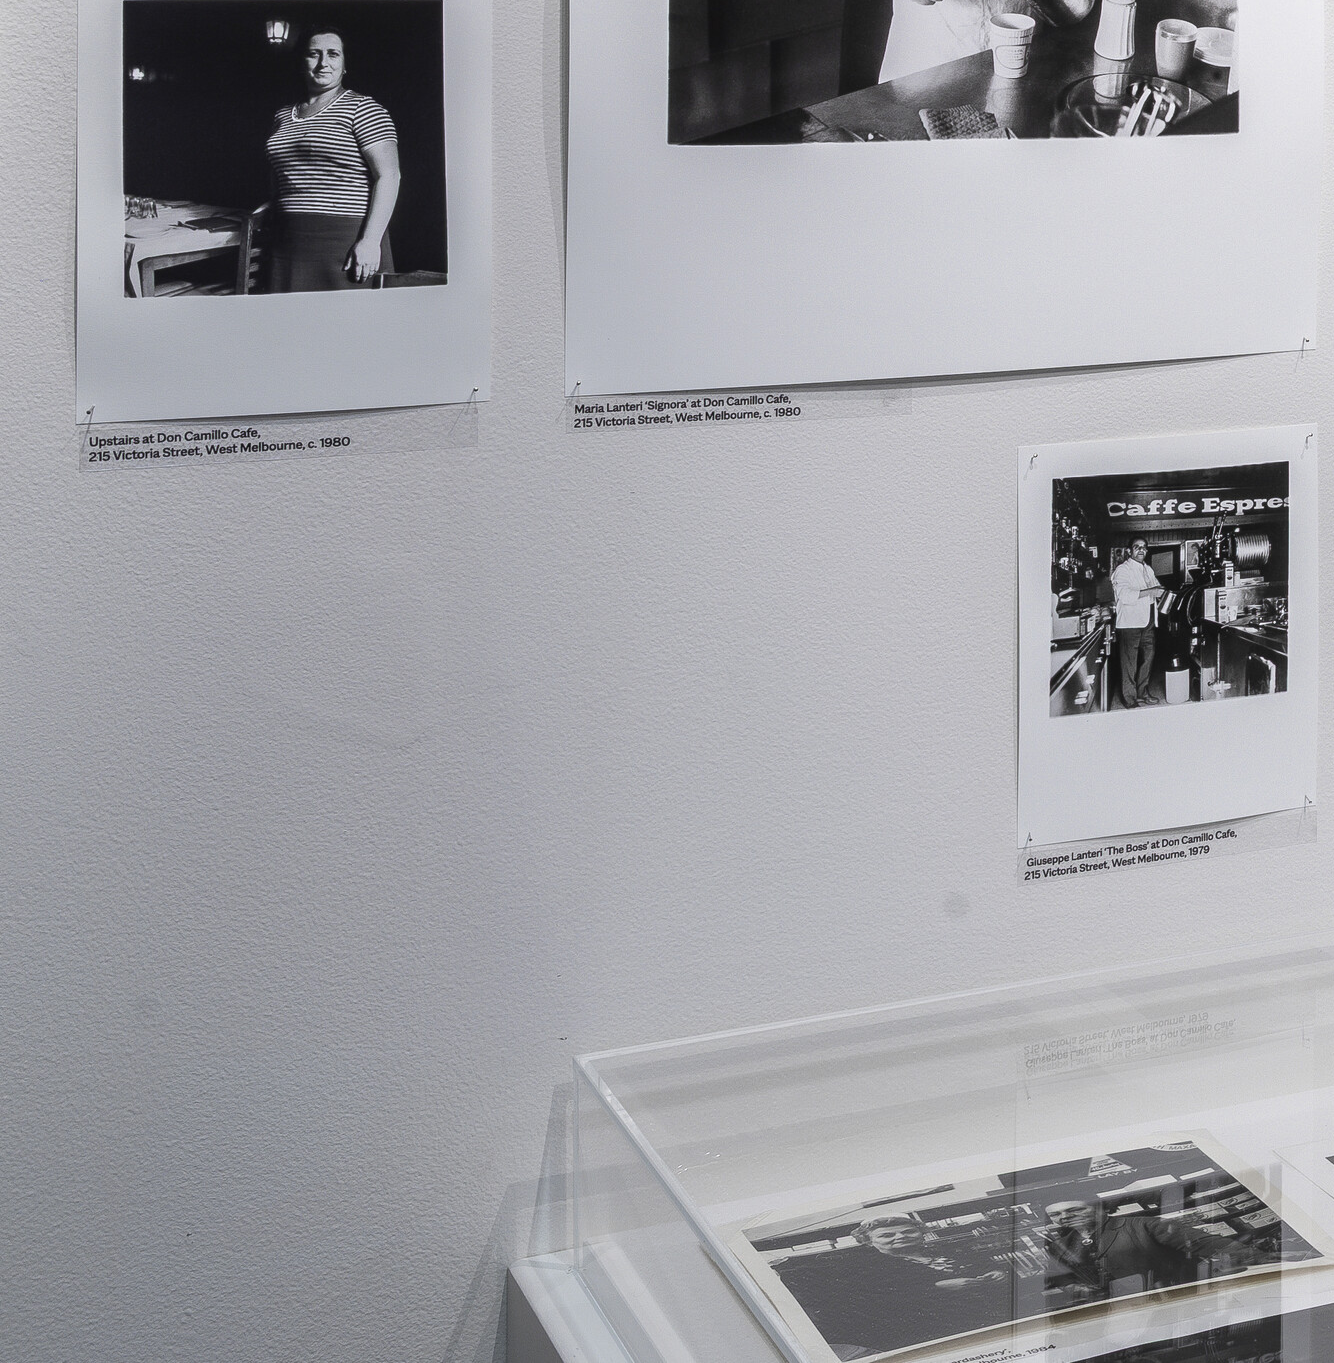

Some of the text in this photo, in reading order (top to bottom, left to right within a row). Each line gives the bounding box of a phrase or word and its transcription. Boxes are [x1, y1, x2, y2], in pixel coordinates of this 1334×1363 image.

[574, 403, 605, 415] Maria
[606, 400, 643, 413] Lanteri
[690, 398, 702, 409] at
[703, 397, 725, 408] Don
[726, 395, 764, 407] Camillo
[765, 393, 792, 405] Cafe,
[573, 406, 802, 429] 215 Victoria Street, West Melbourne, c. 1980
[1107, 498, 1197, 517] Caffe
